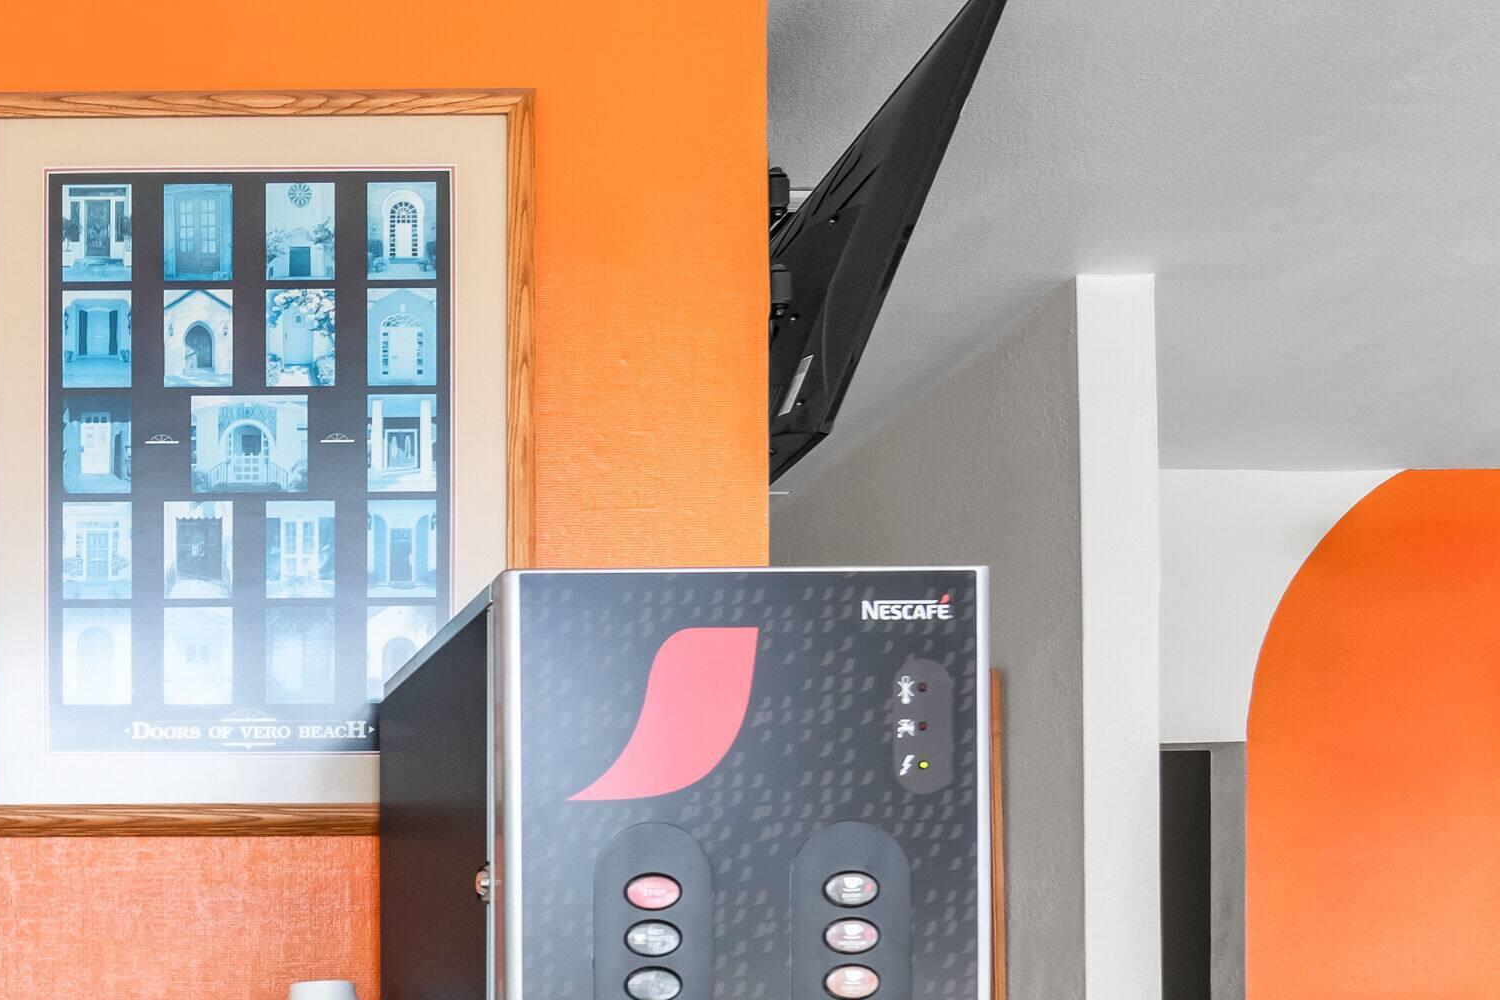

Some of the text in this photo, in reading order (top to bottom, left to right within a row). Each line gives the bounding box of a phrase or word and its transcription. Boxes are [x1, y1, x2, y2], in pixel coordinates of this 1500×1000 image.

[131, 720, 367, 740] DOORS OF VERO BEACH
